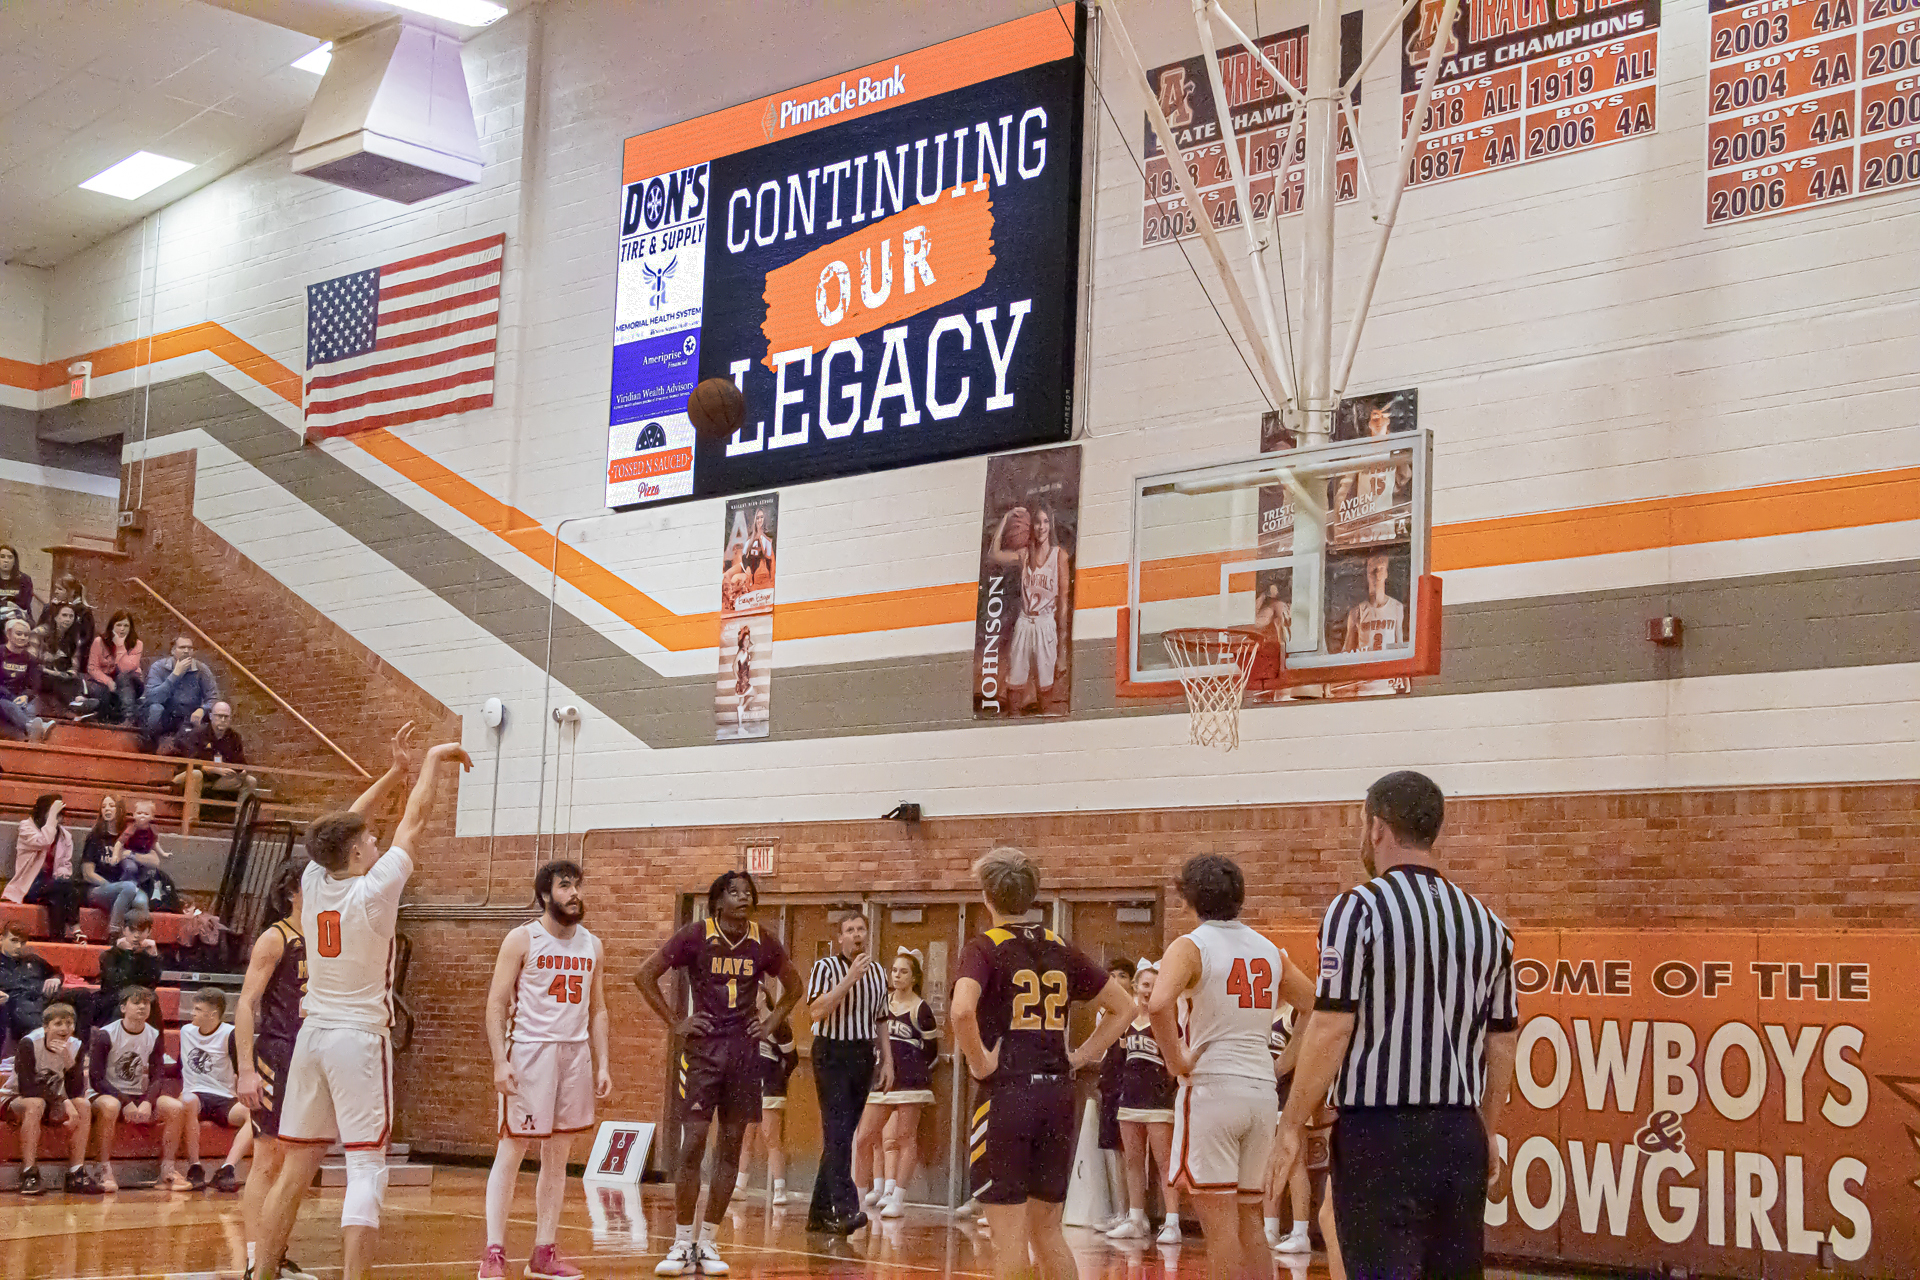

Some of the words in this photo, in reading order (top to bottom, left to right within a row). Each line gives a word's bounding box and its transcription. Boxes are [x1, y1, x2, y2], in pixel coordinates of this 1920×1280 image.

[1494, 10, 1645, 63] CHAMPIONS
[1714, 14, 1789, 60] 2003
[1812, 0, 1852, 33] 4A
[1557, 43, 1625, 68] BOYS
[1744, 45, 1820, 72] BOYS
[1217, 34, 1309, 109] WRESTLI
[1529, 65, 1595, 106] 1919
[1614, 50, 1656, 87] ALL
[1714, 68, 1788, 114] 2004
[1810, 52, 1851, 88] 4A
[780, 81, 857, 129] Pinnacle
[858, 64, 906, 106] Bank
[1431, 77, 1492, 100] BOYS
[1482, 84, 1520, 118] ALL
[1556, 94, 1624, 120] BOYS
[1743, 100, 1819, 128] BOYS
[1426, 126, 1494, 150] GIRLS
[1528, 116, 1596, 157] 2006
[1615, 103, 1653, 137] 4A
[1713, 122, 1787, 167] 2005
[1809, 109, 1850, 144] 4A
[1182, 146, 1222, 162] OYS
[1483, 134, 1517, 166] 4A
[727, 106, 1047, 254] CONTINUING
[1741, 156, 1818, 182] BOYS
[622, 164, 708, 236] DON'S
[1711, 178, 1786, 222] 2006
[1808, 164, 1849, 200] 4A
[1213, 199, 1241, 227] 4A
[621, 238, 646, 262] TIRE
[649, 236, 657, 255] &
[661, 223, 705, 253] SUPPLY
[816, 225, 936, 326] OUR
[616, 318, 649, 332] MEMORIAL
[650, 312, 675, 325] HEALTH
[676, 307, 702, 320] SYSTEM
[643, 350, 682, 365] Ameriprise
[616, 391, 641, 404] Viridian
[643, 385, 665, 398] Wealth
[666, 381, 694, 394] Advisors
[726, 299, 1032, 457] LEGACY
[613, 461, 645, 479] TOSSED
[653, 453, 688, 472] SAUCED
[638, 482, 660, 498] Pizza
[1340, 492, 1373, 511] AYDEN
[1262, 514, 1295, 532] COTTO
[1339, 502, 1376, 522] TAYLOR
[981, 576, 1004, 713] JOHNSON
[753, 848, 771, 876] EXIT
[317, 910, 342, 958] 0
[536, 954, 593, 972] COWBOYS
[711, 957, 755, 976] HAYS
[548, 974, 583, 1004] 45
[725, 978, 739, 1009] 1
[1226, 957, 1272, 1009] 42
[1514, 958, 1632, 997] OME
[1652, 960, 1732, 998] OF
[1750, 962, 1870, 1002] THE
[1009, 968, 1069, 1031] 22
[887, 1020, 912, 1038] HS
[1507, 1014, 1870, 1129] OWBOYS
[1634, 1109, 1686, 1156] &
